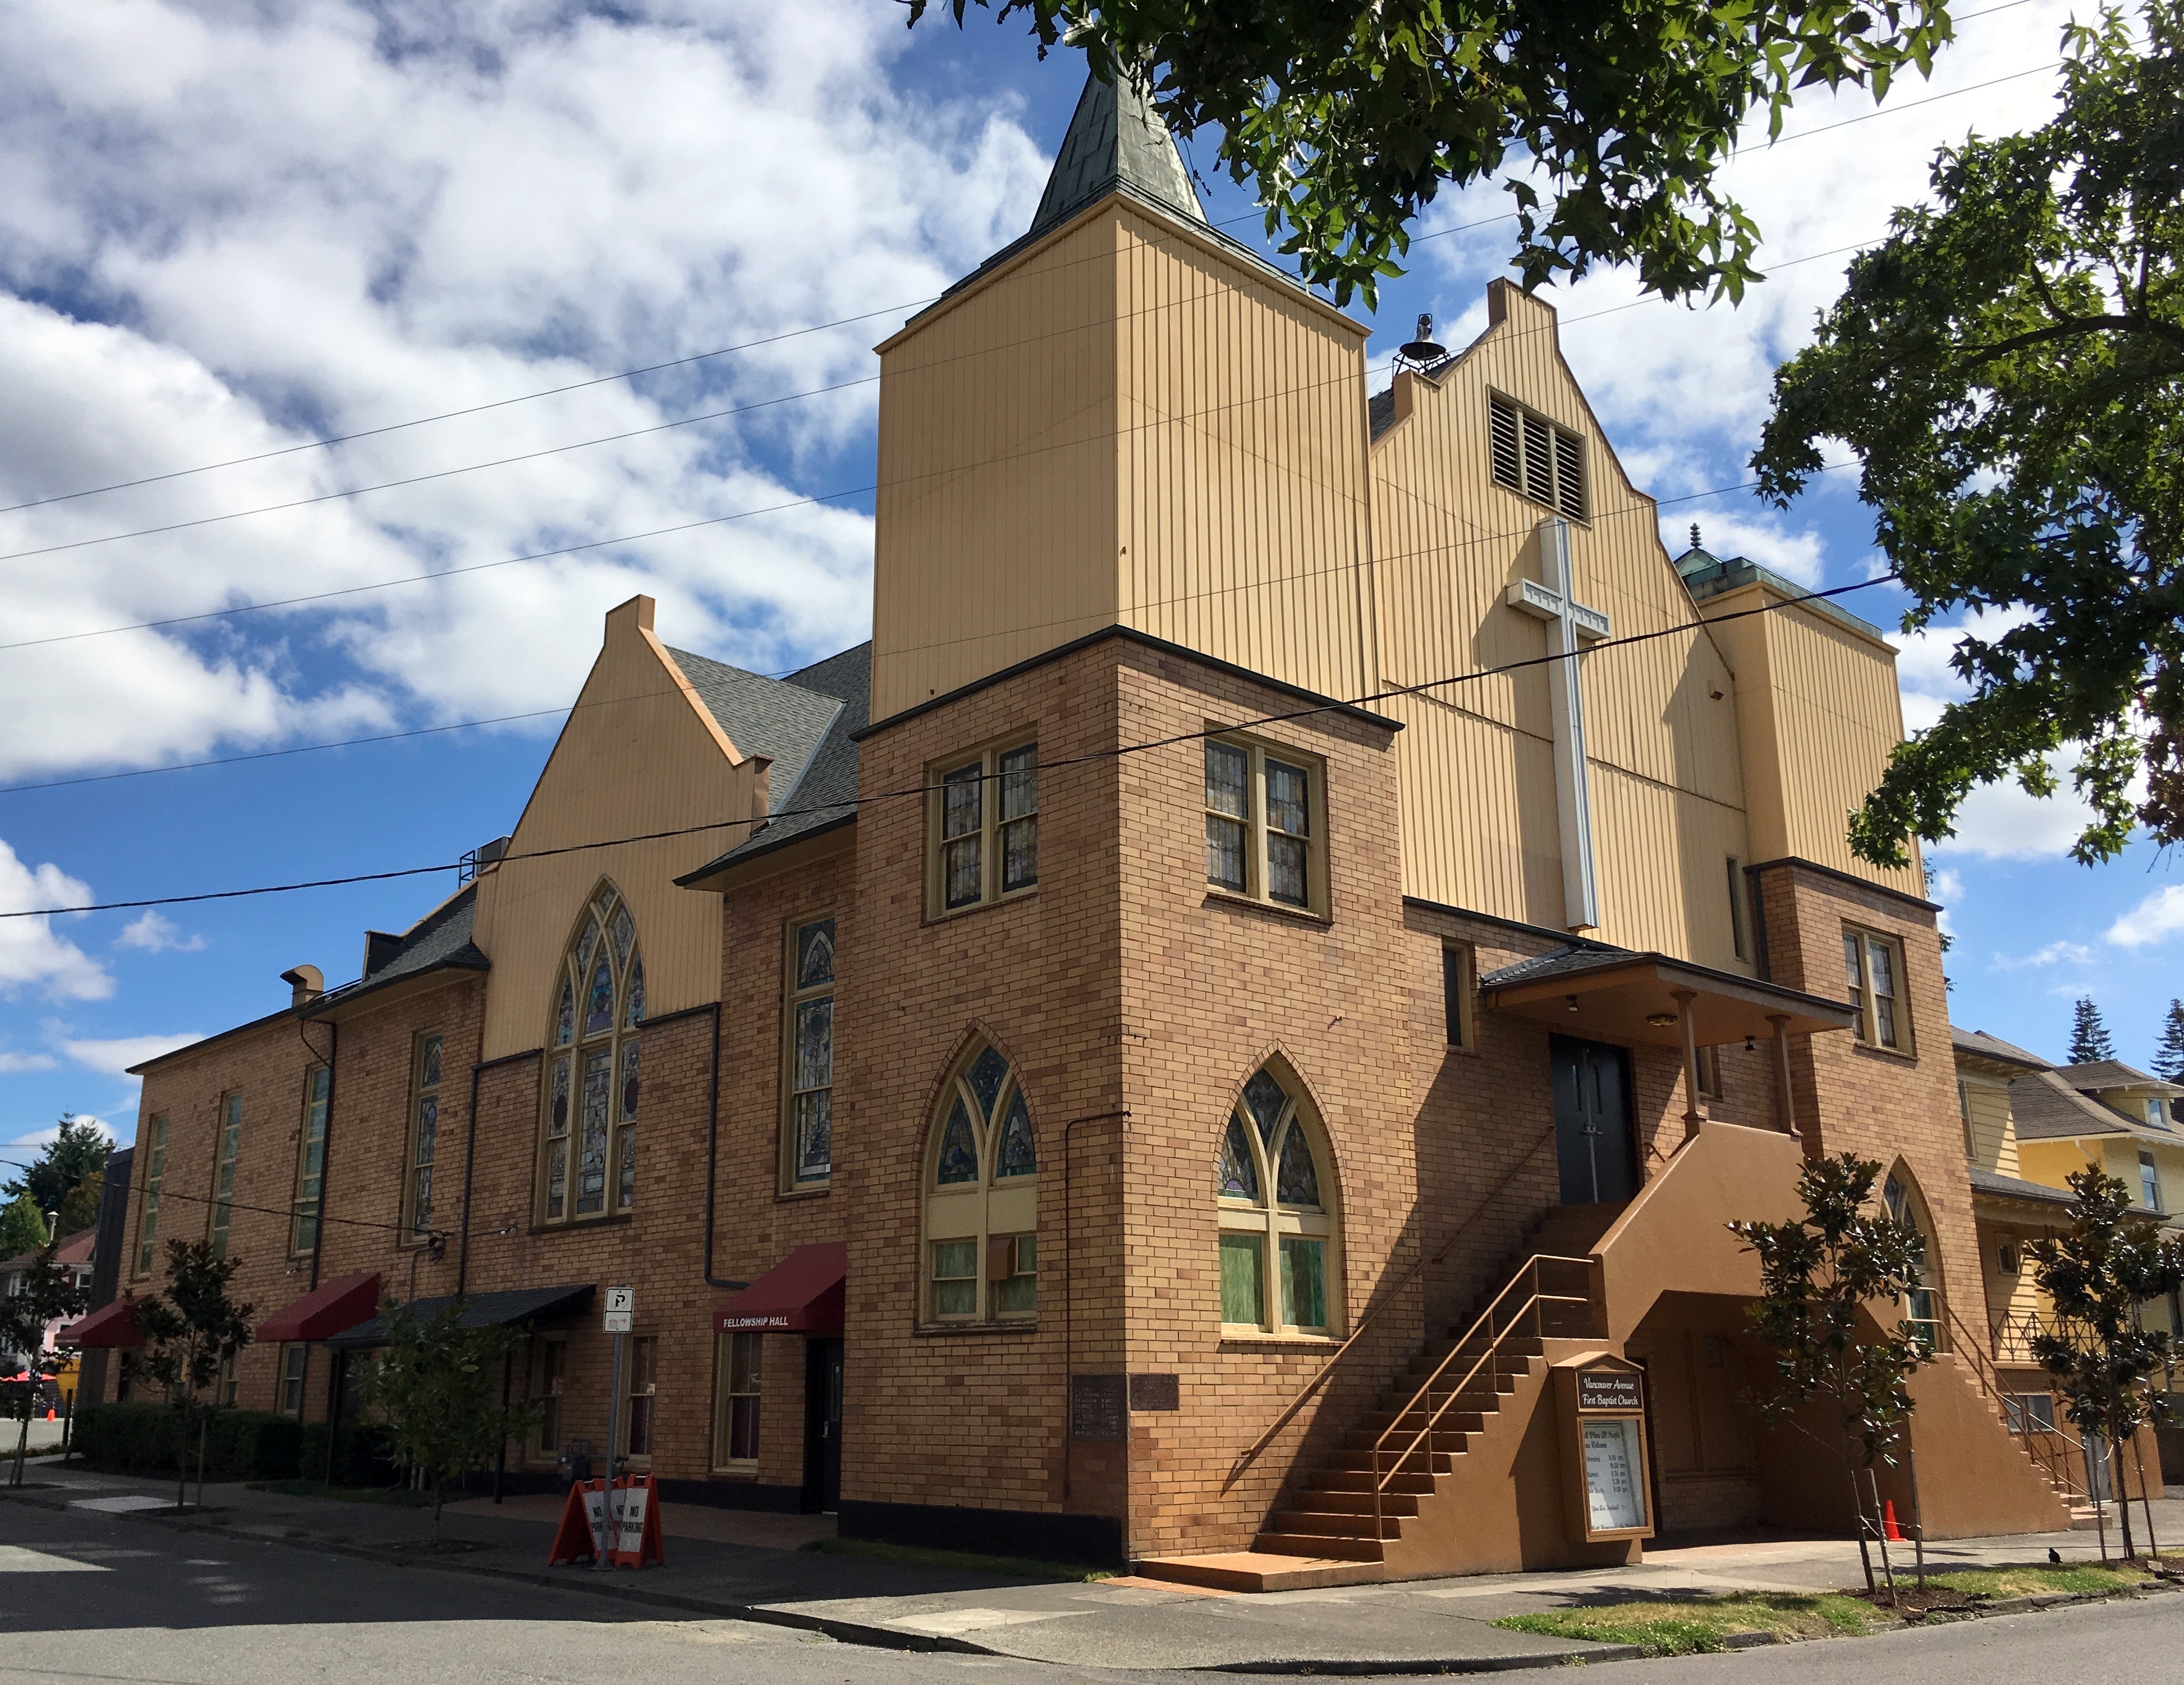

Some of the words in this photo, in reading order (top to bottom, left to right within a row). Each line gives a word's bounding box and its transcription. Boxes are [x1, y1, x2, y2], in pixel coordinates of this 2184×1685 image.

[615, 1294, 625, 1307] P
[723, 1316, 768, 1328] FELLOWSHIP
[769, 1316, 788, 1326] HALL
[1584, 1377, 1612, 1389] Vancouver
[1613, 1379, 1634, 1389] Avenue
[1582, 1394, 1596, 1405] First
[1596, 1394, 1617, 1407] Baptist
[1618, 1394, 1638, 1405] Church
[593, 1506, 602, 1518] NO
[629, 1506, 639, 1518] NO
[622, 1521, 643, 1533] PARKING
